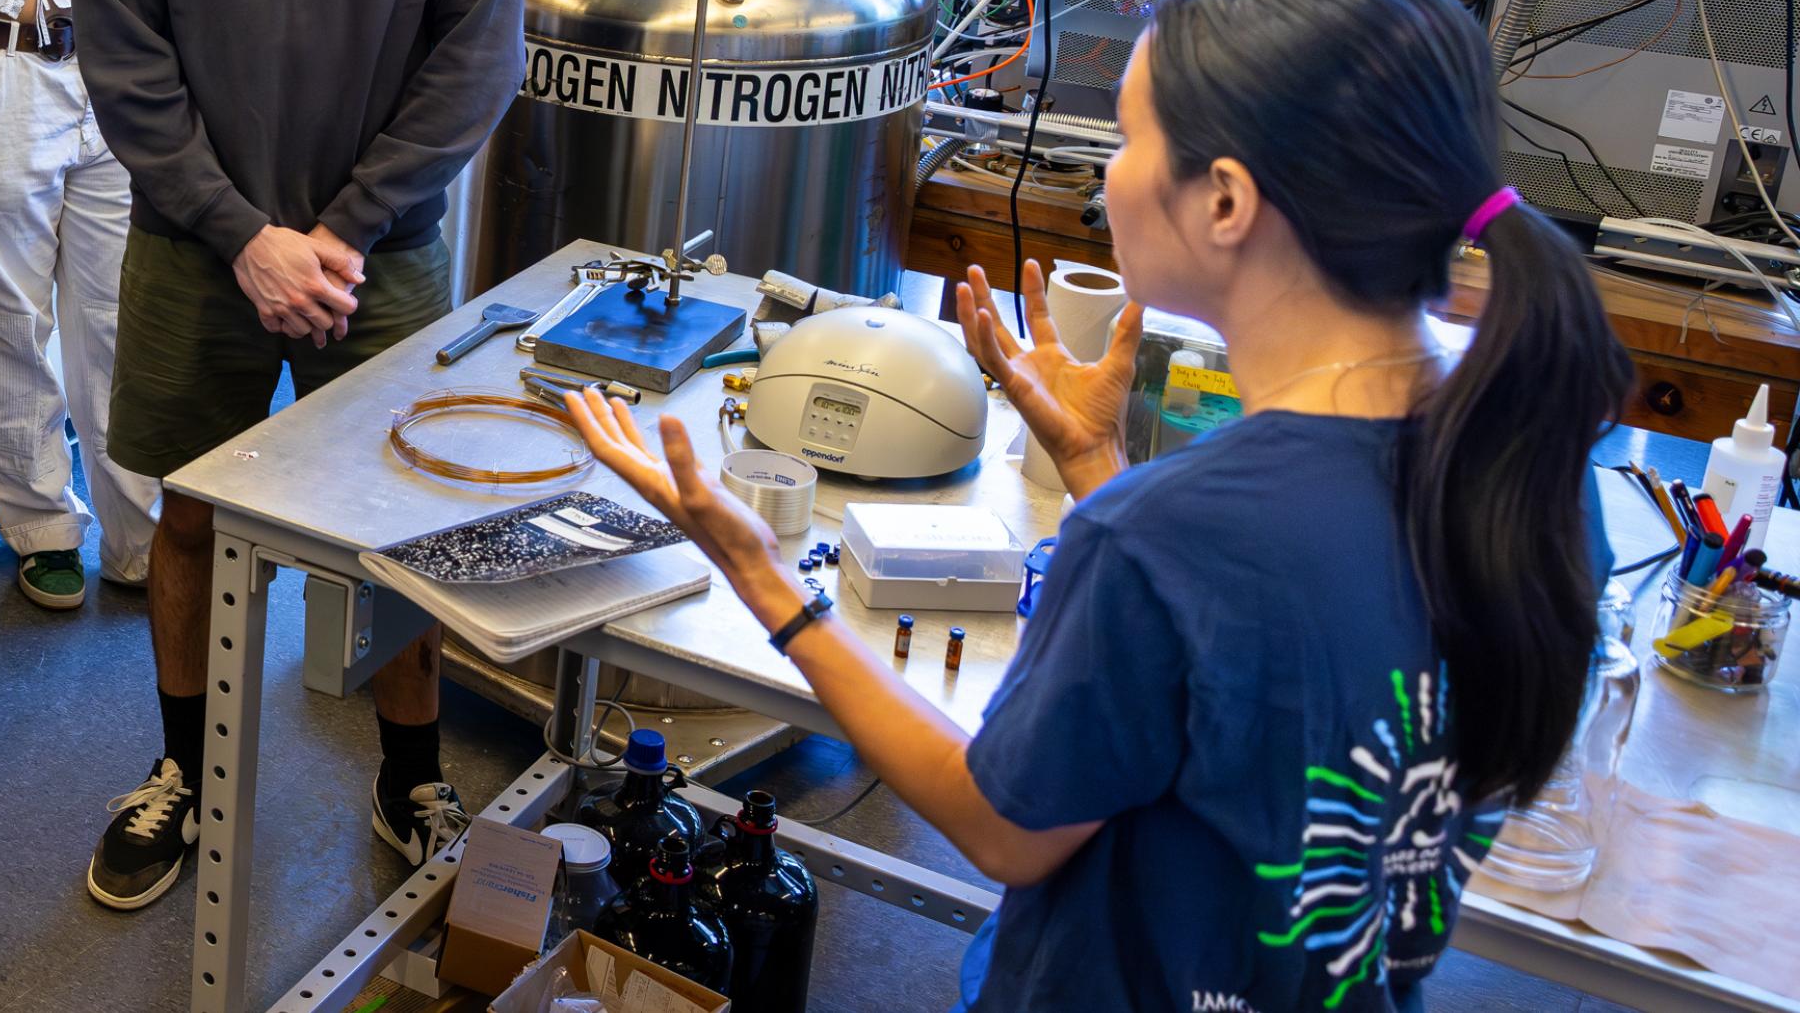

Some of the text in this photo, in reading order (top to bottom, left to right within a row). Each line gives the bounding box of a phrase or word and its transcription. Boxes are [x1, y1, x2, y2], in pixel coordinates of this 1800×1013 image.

[519, 47, 637, 113] OGEN
[1739, 127, 1762, 141] CE
[801, 447, 845, 464] eppendorf
